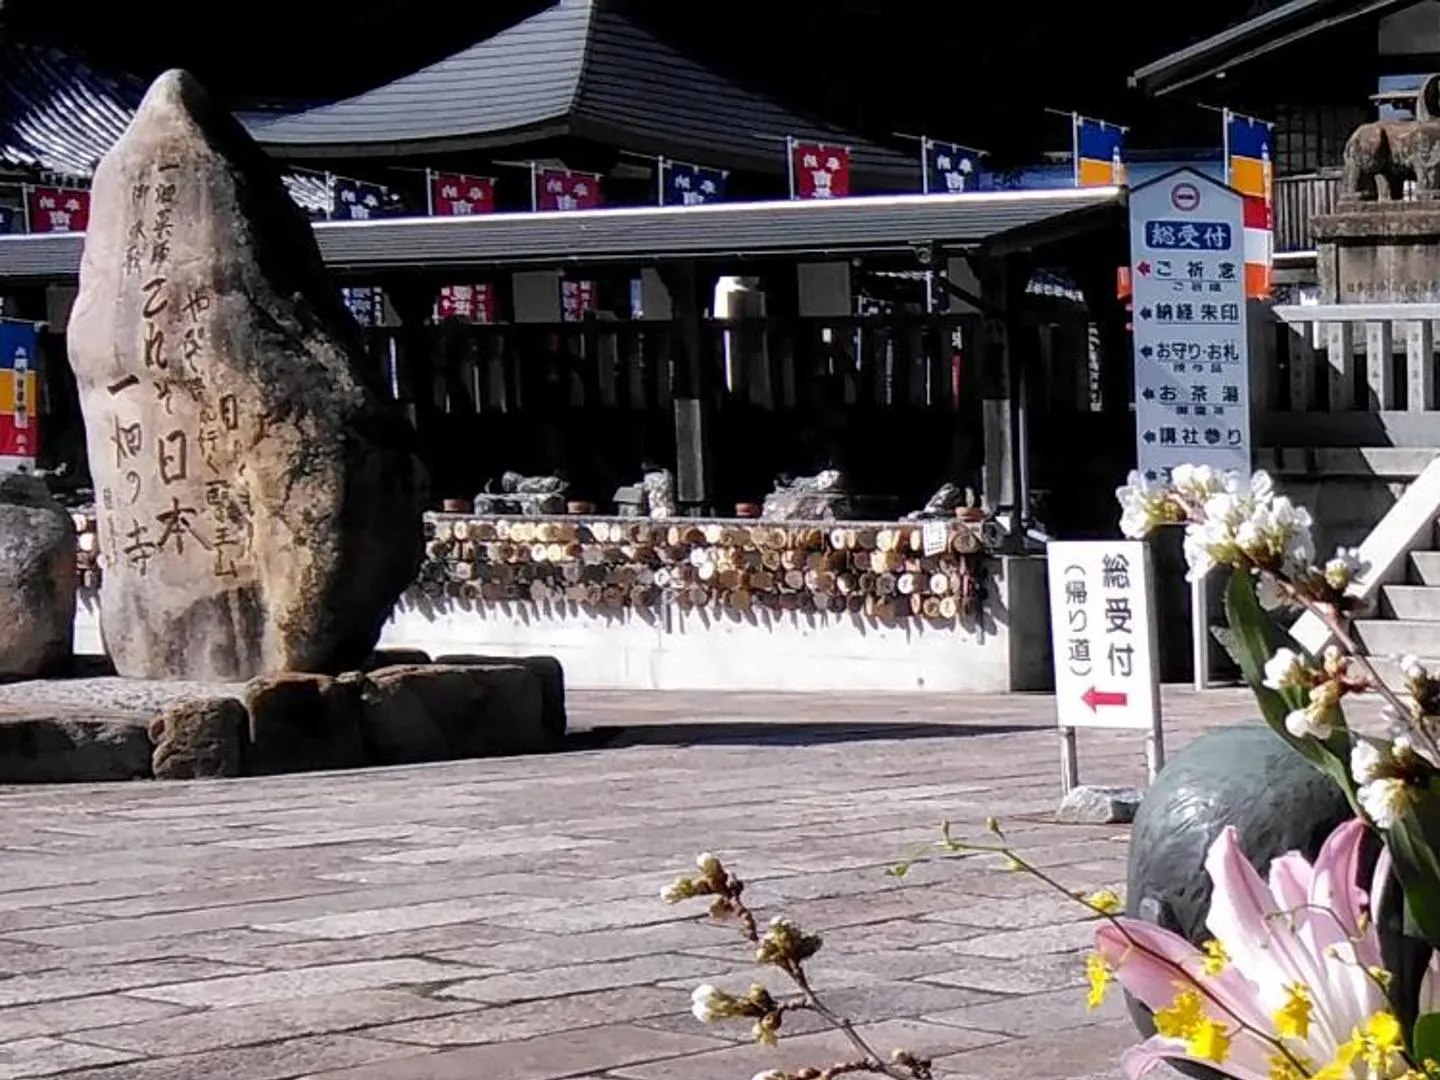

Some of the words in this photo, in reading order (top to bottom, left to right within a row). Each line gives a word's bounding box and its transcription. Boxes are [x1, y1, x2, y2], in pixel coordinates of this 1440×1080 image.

[1152, 222, 1228, 249] 総受付
[1102, 553, 1135, 678] 総受付
